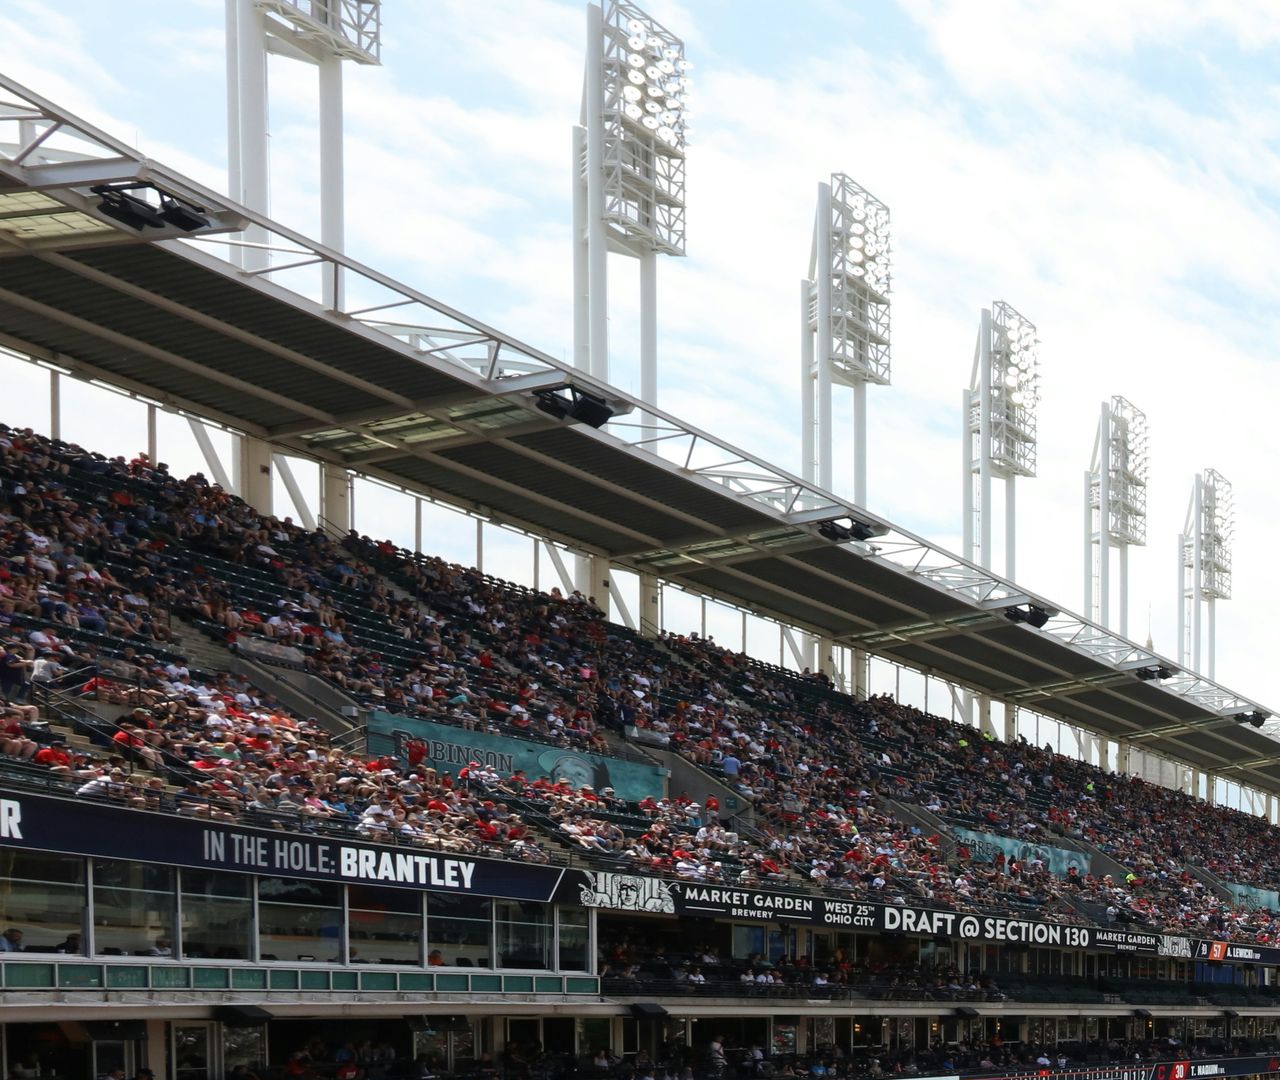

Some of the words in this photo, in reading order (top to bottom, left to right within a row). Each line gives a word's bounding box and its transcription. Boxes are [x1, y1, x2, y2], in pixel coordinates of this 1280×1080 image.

[204, 830, 224, 861] IN
[231, 834, 268, 867] THE
[275, 840, 336, 874] HOLE:
[340, 847, 475, 889] BRANTLEY
[685, 887, 749, 906] MARKET
[754, 894, 813, 912] GARDEN
[731, 907, 773, 919] BREWERY
[824, 901, 853, 914] WEST
[824, 913, 851, 925] OHIO
[853, 916, 875, 927] CITY
[884, 906, 955, 935] DRAFT
[959, 916, 980, 938] @
[984, 918, 1061, 945] SECTION
[1064, 927, 1089, 947] 130
[1095, 930, 1126, 943] MARKET
[1127, 934, 1156, 946] GARDEN
[1175, 1064, 1184, 1079] 30
